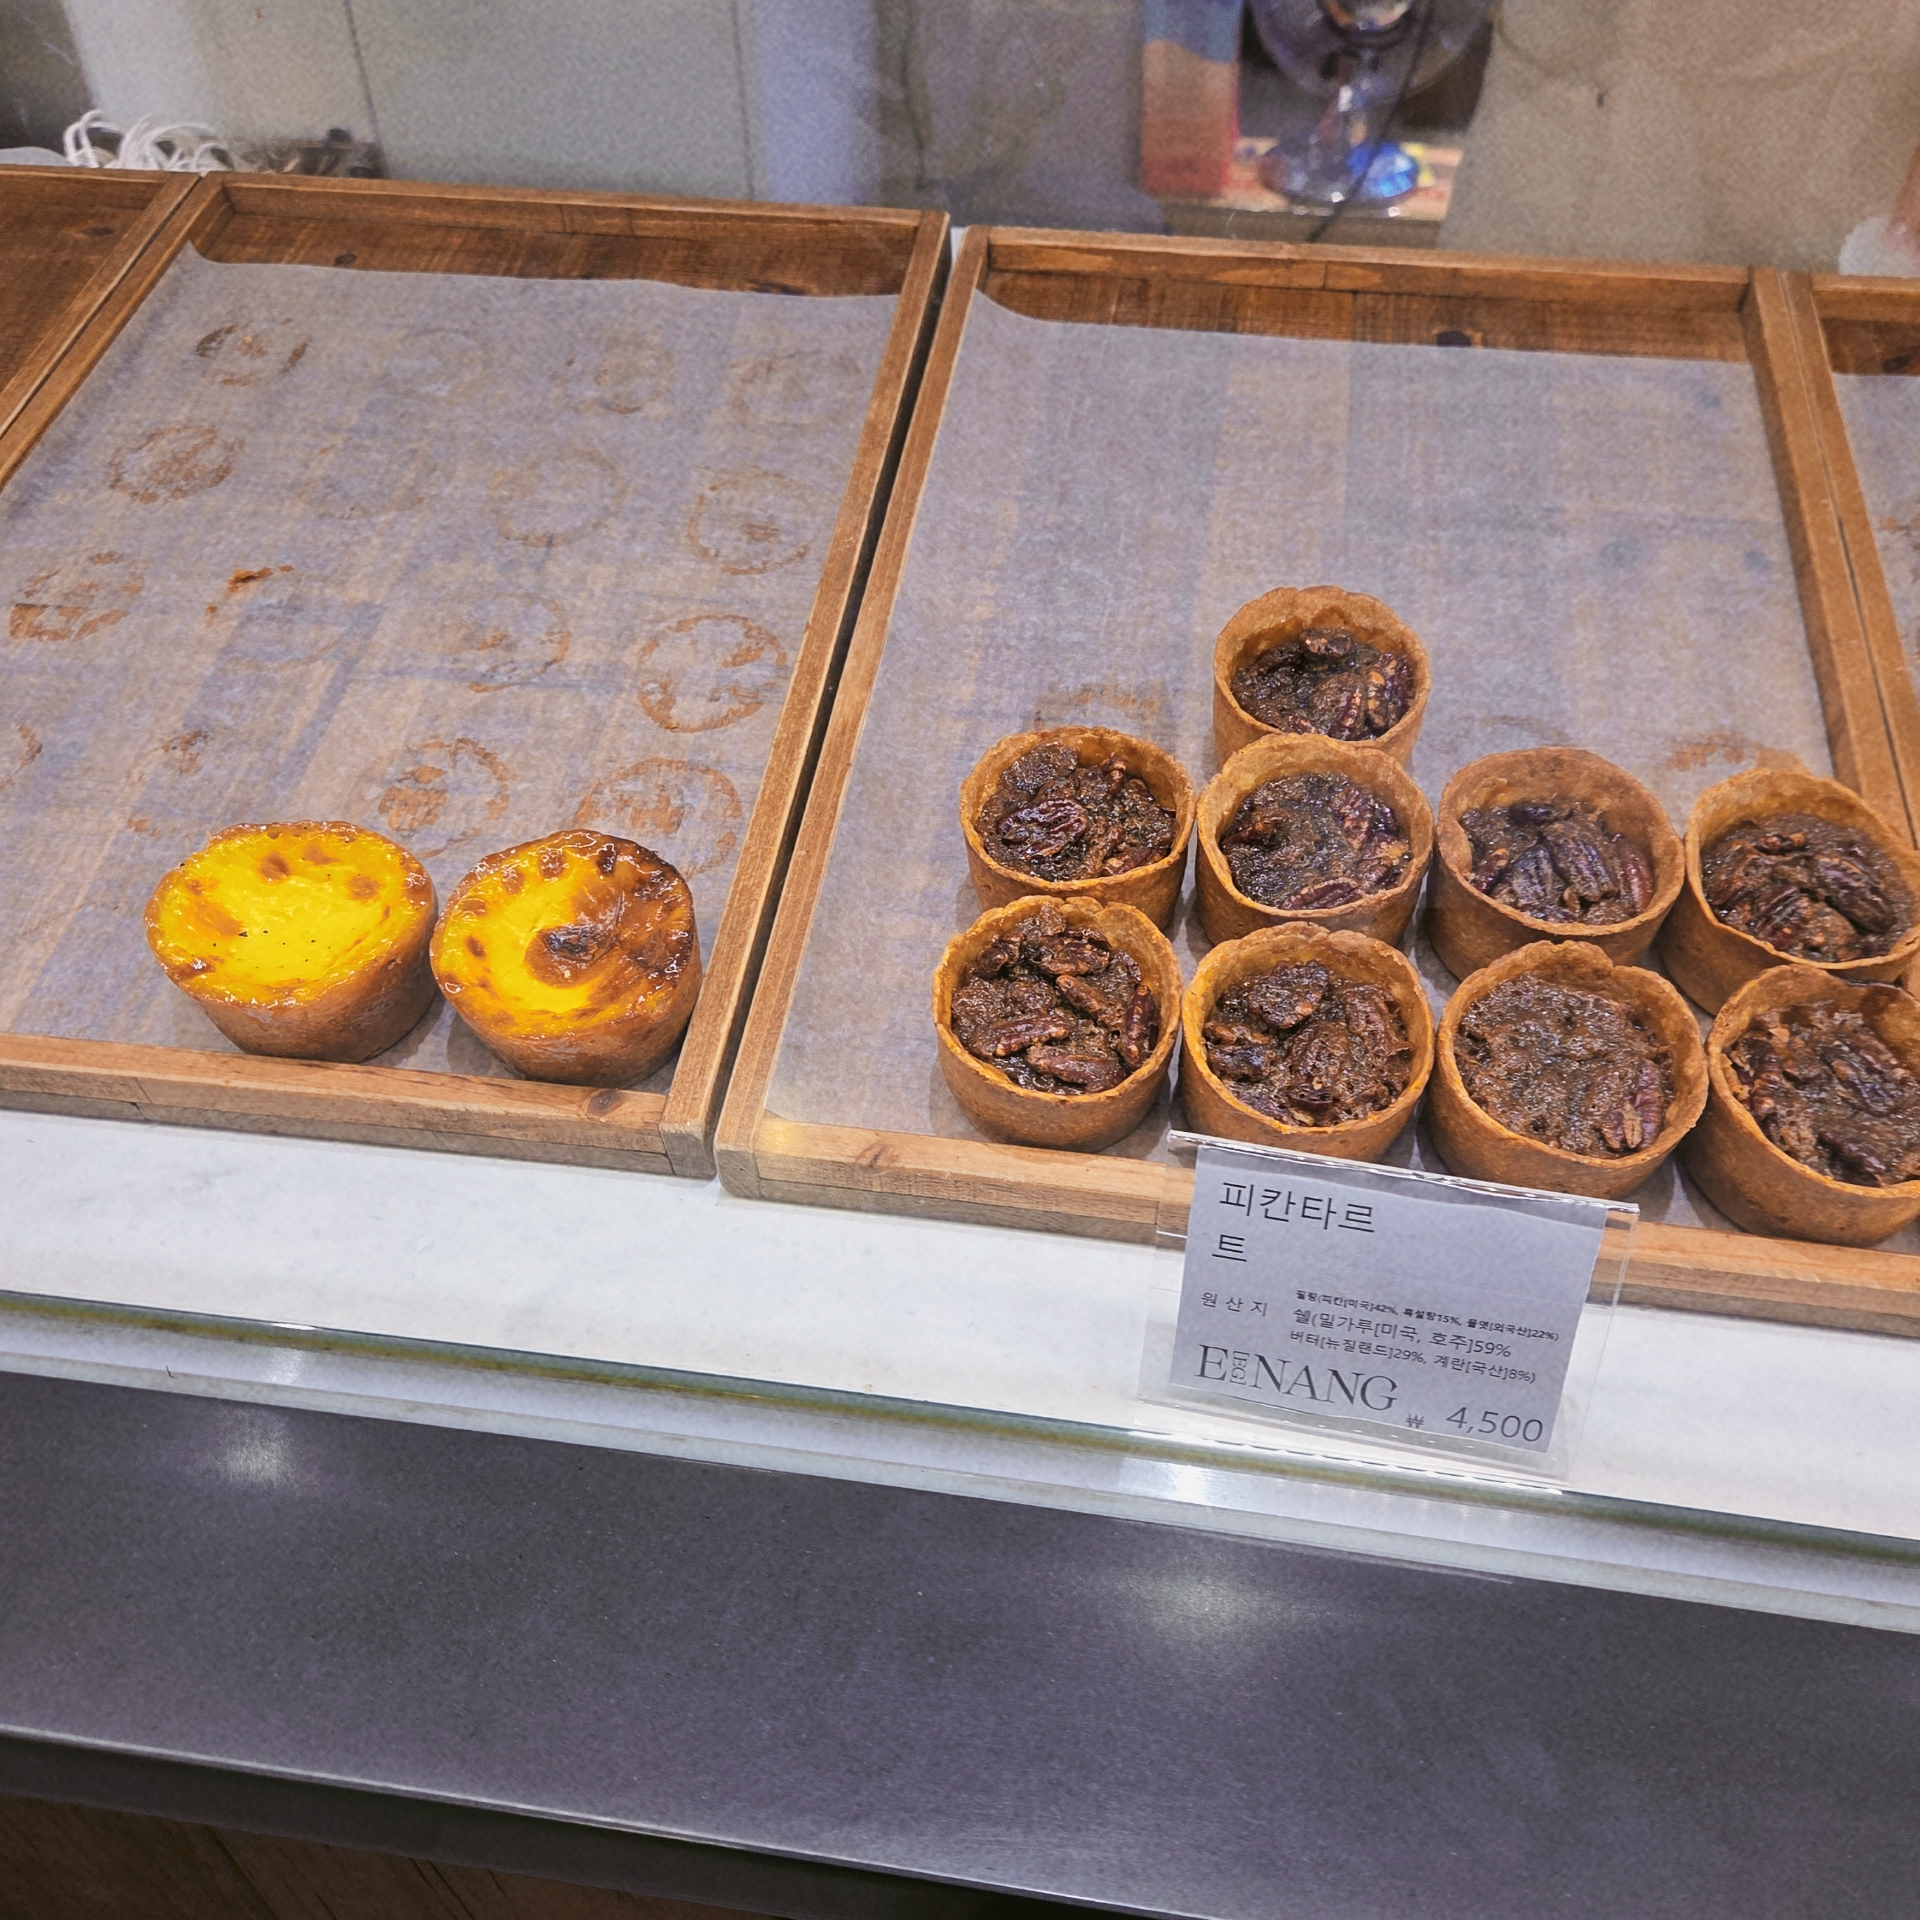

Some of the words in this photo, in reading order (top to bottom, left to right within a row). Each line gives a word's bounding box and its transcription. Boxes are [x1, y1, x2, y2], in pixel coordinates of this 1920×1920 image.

[1219, 1182, 1375, 1233] 피칸타르
[1212, 1234, 1247, 1262] 트
[1289, 1330, 1427, 1364] 버터[뉴질랜드]29%,
[1433, 1354, 1536, 1384] 계란[국산]8%)
[1428, 1332, 1511, 1358] 호주]59%
[1445, 1406, 1544, 1442] 4,500
